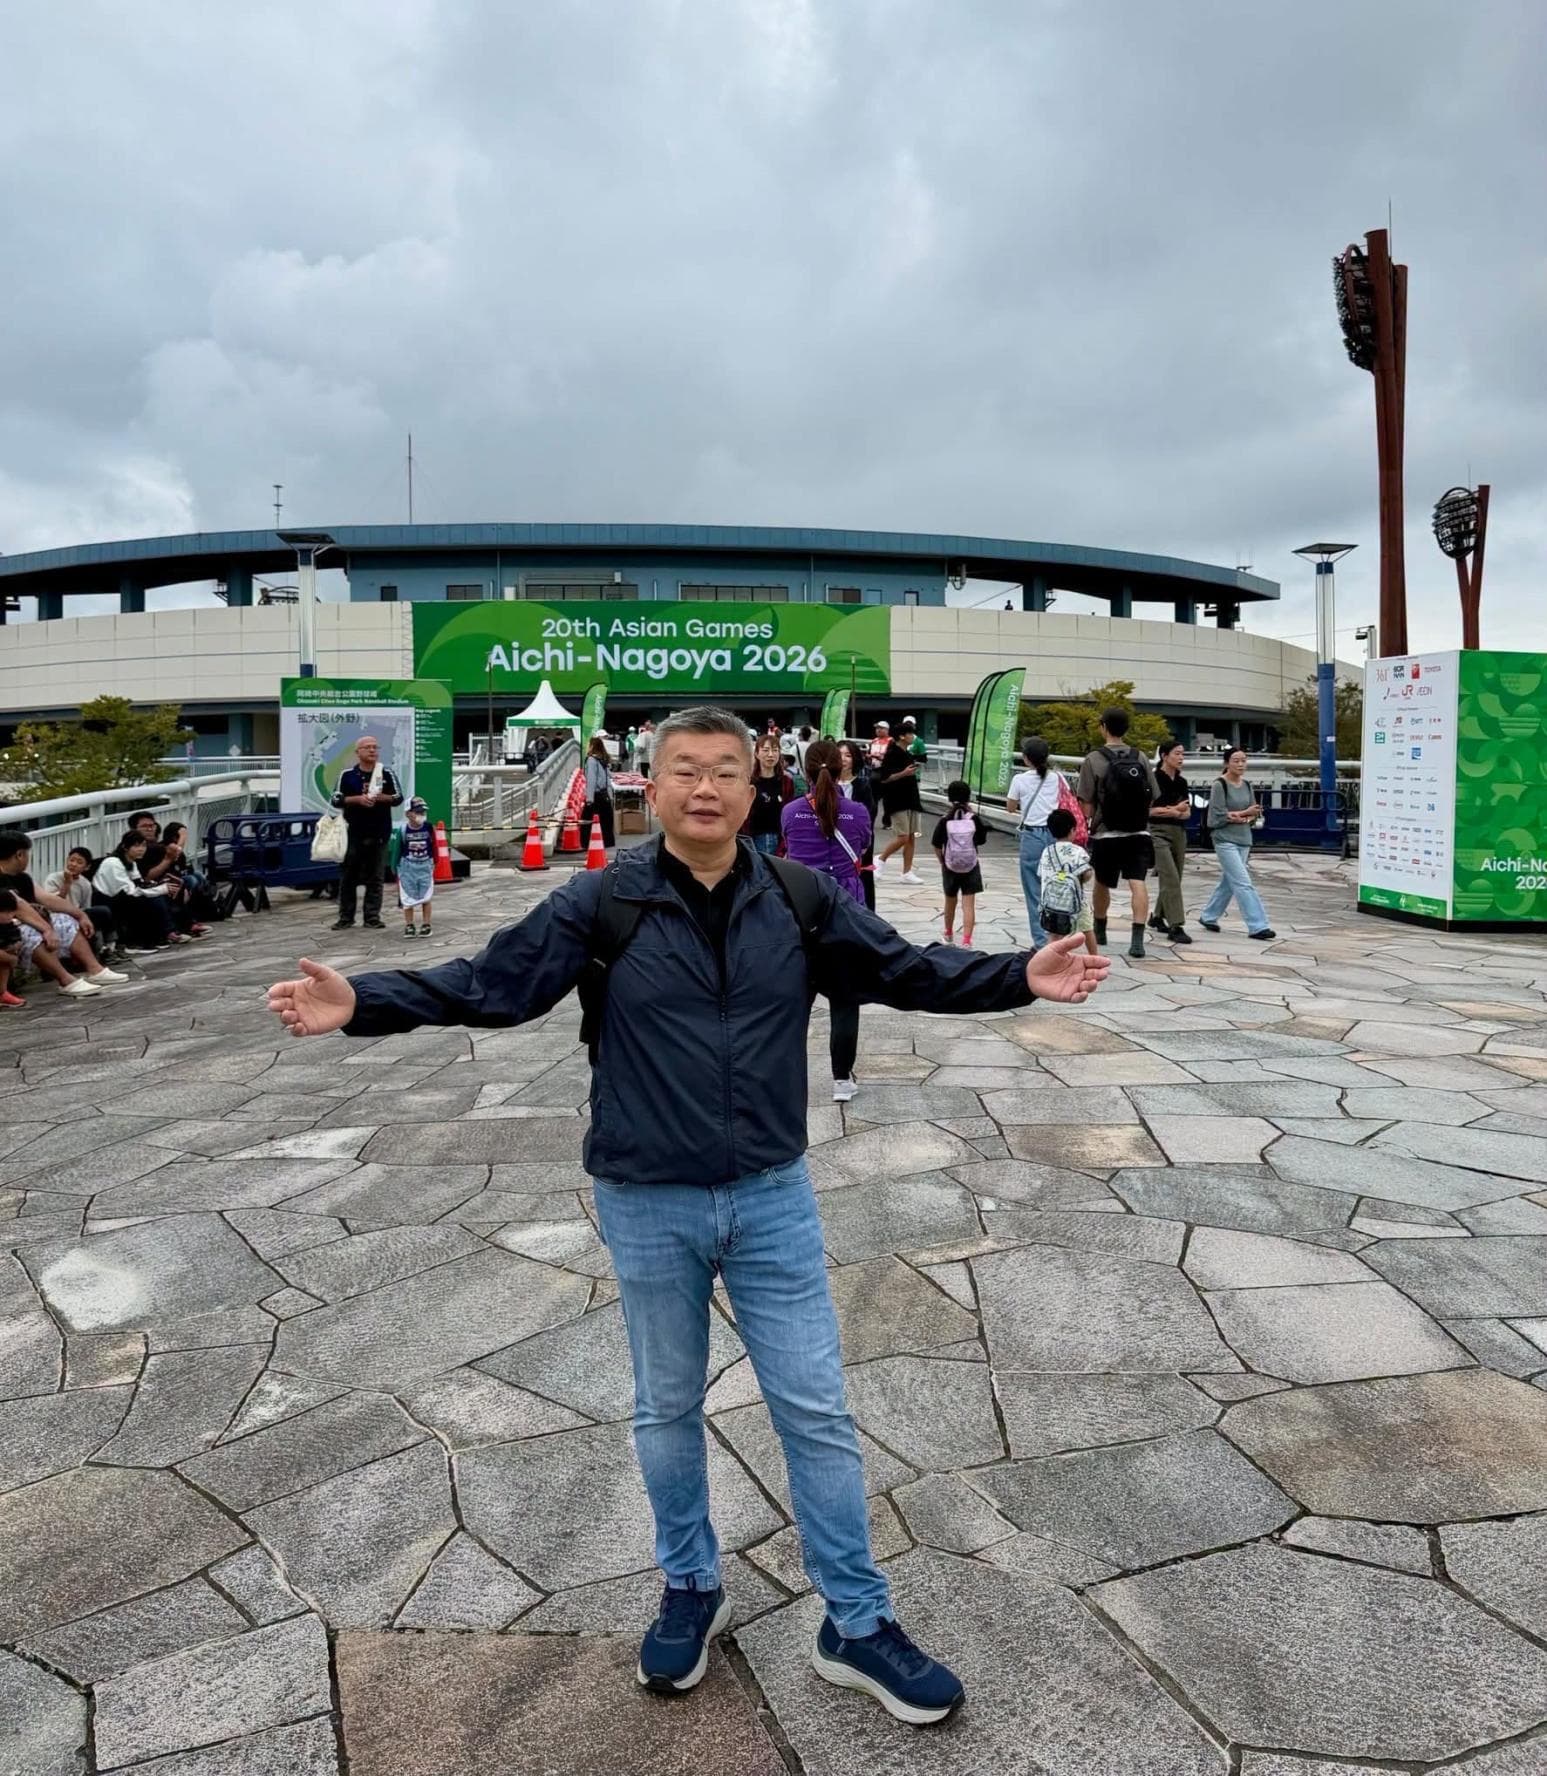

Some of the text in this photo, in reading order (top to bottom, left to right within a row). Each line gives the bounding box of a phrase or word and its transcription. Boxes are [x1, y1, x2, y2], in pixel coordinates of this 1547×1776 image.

[541, 616, 773, 639] 20th Asian Games
[485, 641, 827, 680] Aichi-Nagoya 2026
[998, 684, 1019, 788] Aichi-Nagoya 2026
[1515, 875, 1547, 890] 202
